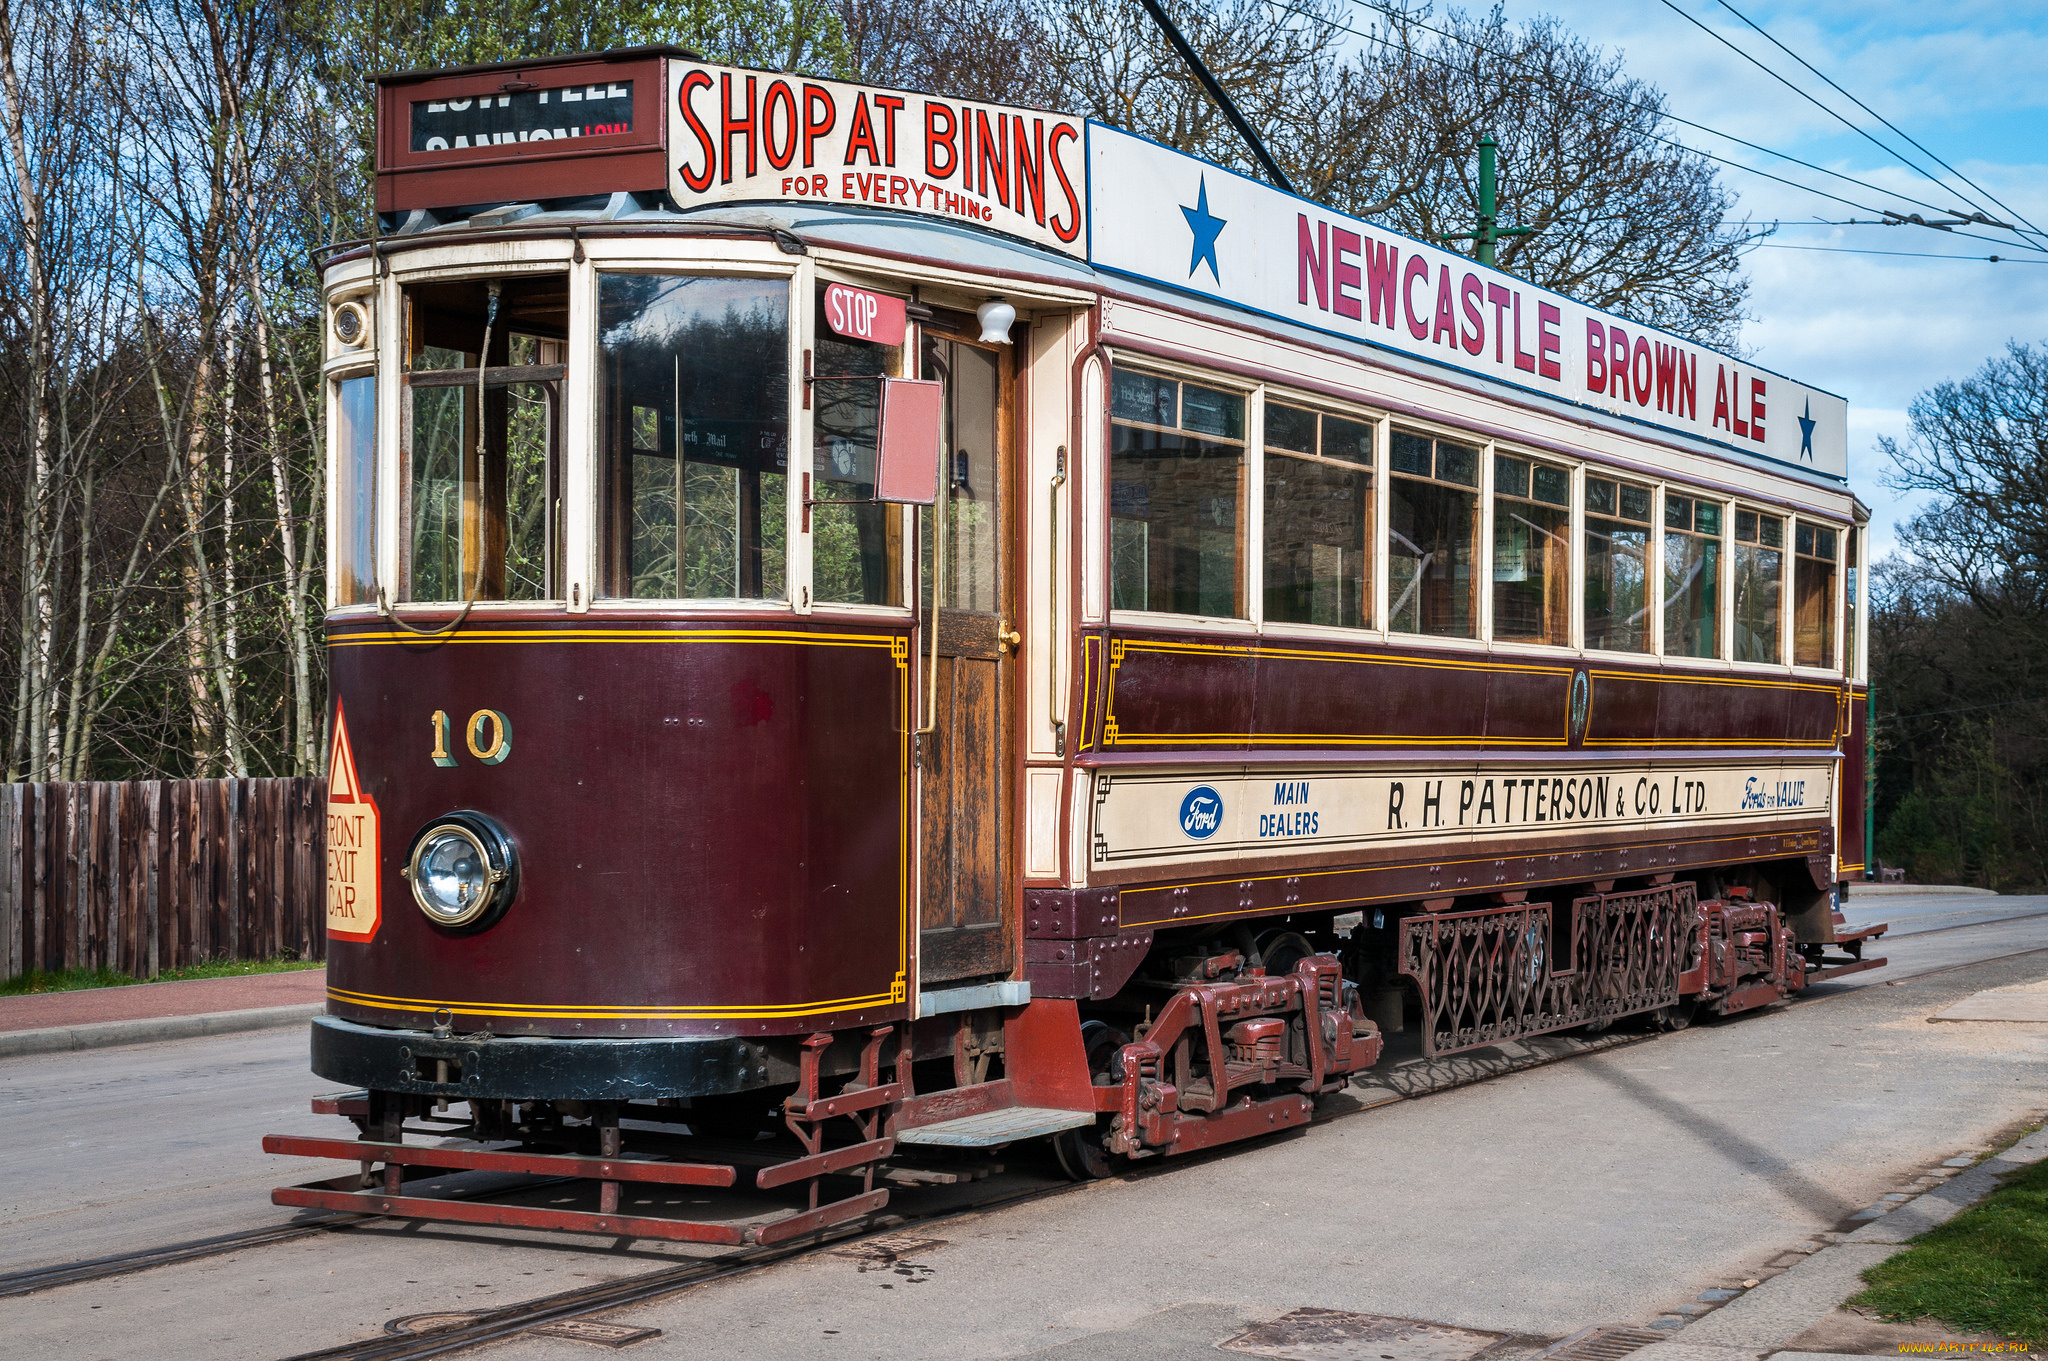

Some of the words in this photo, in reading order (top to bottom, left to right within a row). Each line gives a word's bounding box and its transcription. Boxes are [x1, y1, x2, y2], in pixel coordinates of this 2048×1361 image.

[678, 69, 836, 193] SHOP
[844, 91, 905, 168] AT
[924, 100, 1081, 243] BINNS
[782, 174, 828, 197] FOR
[842, 173, 993, 221] EVERYTHING
[831, 287, 877, 338] STOP
[1297, 212, 1561, 381] NEWCASTLE
[1586, 317, 1696, 421] BROWN
[1713, 363, 1766, 443] ALE
[684, 430, 698, 445] orth
[706, 432, 727, 447] Mail
[431, 709, 513, 767] 10
[1274, 782, 1310, 805] MAIN
[1387, 781, 1408, 830] R.
[1422, 780, 1445, 827] H.
[1458, 776, 1610, 825] PATTERSON
[1616, 786, 1625, 817] &
[1742, 776, 1766, 810] Fords
[1776, 781, 1805, 808] VALUE
[1184, 796, 1217, 831] Ford
[1259, 811, 1319, 837] DEALERS
[328, 849, 358, 884] EXIT
[328, 883, 356, 919] CAR
